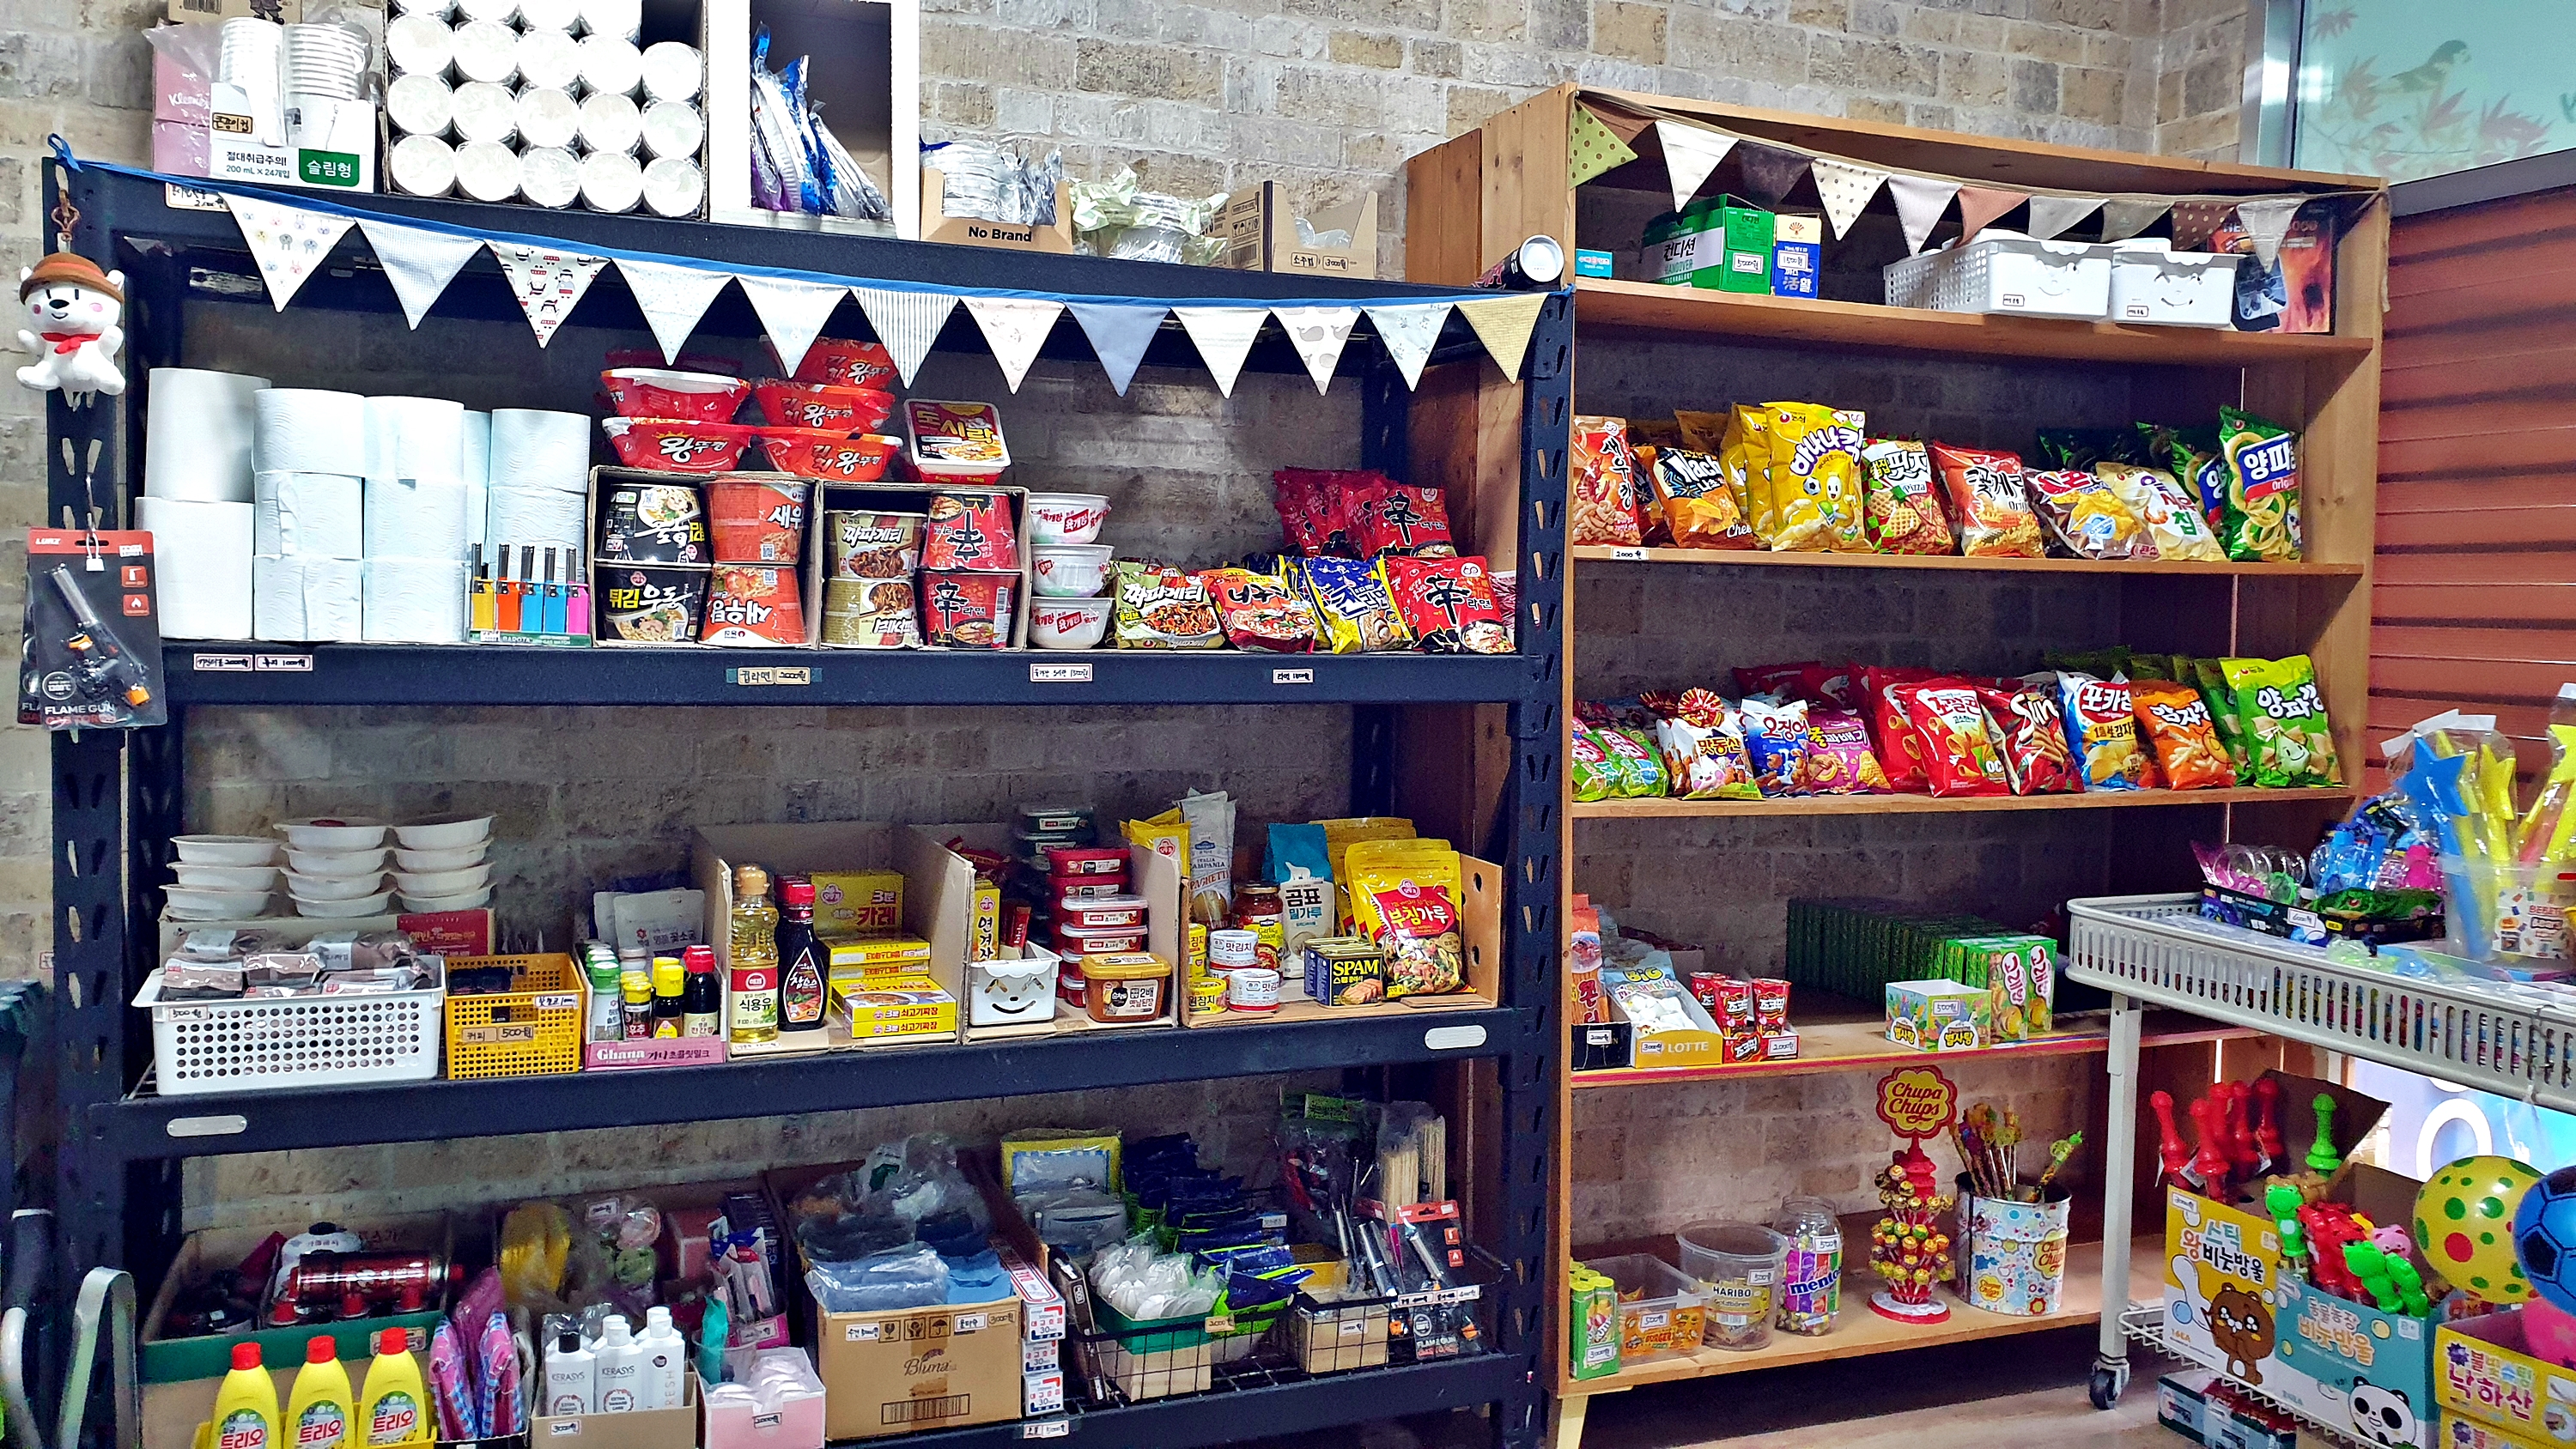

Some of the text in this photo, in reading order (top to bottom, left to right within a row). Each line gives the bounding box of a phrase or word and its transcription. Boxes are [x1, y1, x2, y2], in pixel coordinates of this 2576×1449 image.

[227, 165, 241, 174] 200
[307, 161, 351, 178] 슬림형
[969, 227, 1032, 242] No Brand
[1663, 237, 1697, 261] 컨디션
[916, 410, 994, 444] 도시락
[659, 436, 729, 464] 왕뚜껑
[1789, 425, 1865, 476] 바나나킥
[1599, 433, 1633, 511] 새우깡
[1666, 451, 1722, 483] Nach
[2243, 442, 2298, 482] 양파
[1902, 482, 1926, 494] Pizza
[1382, 490, 1423, 546] 辛
[841, 525, 904, 549] 짜파게티
[609, 588, 640, 609] 튀김
[933, 579, 969, 631] 辛
[1121, 582, 1204, 609] 짜파게티
[1425, 573, 1472, 627] 辛
[1466, 597, 1493, 610] 라면
[962, 604, 986, 615] 라면
[45, 706, 86, 715] FLAME
[1696, 736, 1742, 758] 맛동산
[1191, 861, 1226, 870] AMPANIA
[1189, 870, 1230, 891] PAGHETTI
[872, 889, 896, 904] 3분
[1285, 888, 1322, 907] 곰표
[856, 906, 896, 927] 카레
[1289, 906, 1322, 920] 밀가루
[1388, 904, 1449, 929] 부침가루
[977, 915, 994, 960] 연겨자
[1225, 943, 1252, 953] 맛김치
[1332, 959, 1380, 977] SPAM
[739, 997, 772, 1011] 식용유
[466, 1030, 486, 1041] 커피
[596, 1048, 645, 1060] Ghana
[648, 1051, 667, 1060] 가나
[1667, 1041, 1710, 1053] LOTTE
[1892, 1082, 1944, 1102] Chupa
[1888, 1098, 1941, 1124] Chups
[2206, 1221, 2241, 1252] 스틱
[1713, 1286, 1752, 1298] HARIBO
[602, 1366, 635, 1376] KERASYS
[2449, 1362, 2534, 1422] 낙하산
[299, 1419, 342, 1443] 트리오
[373, 1410, 414, 1434] 트리오
